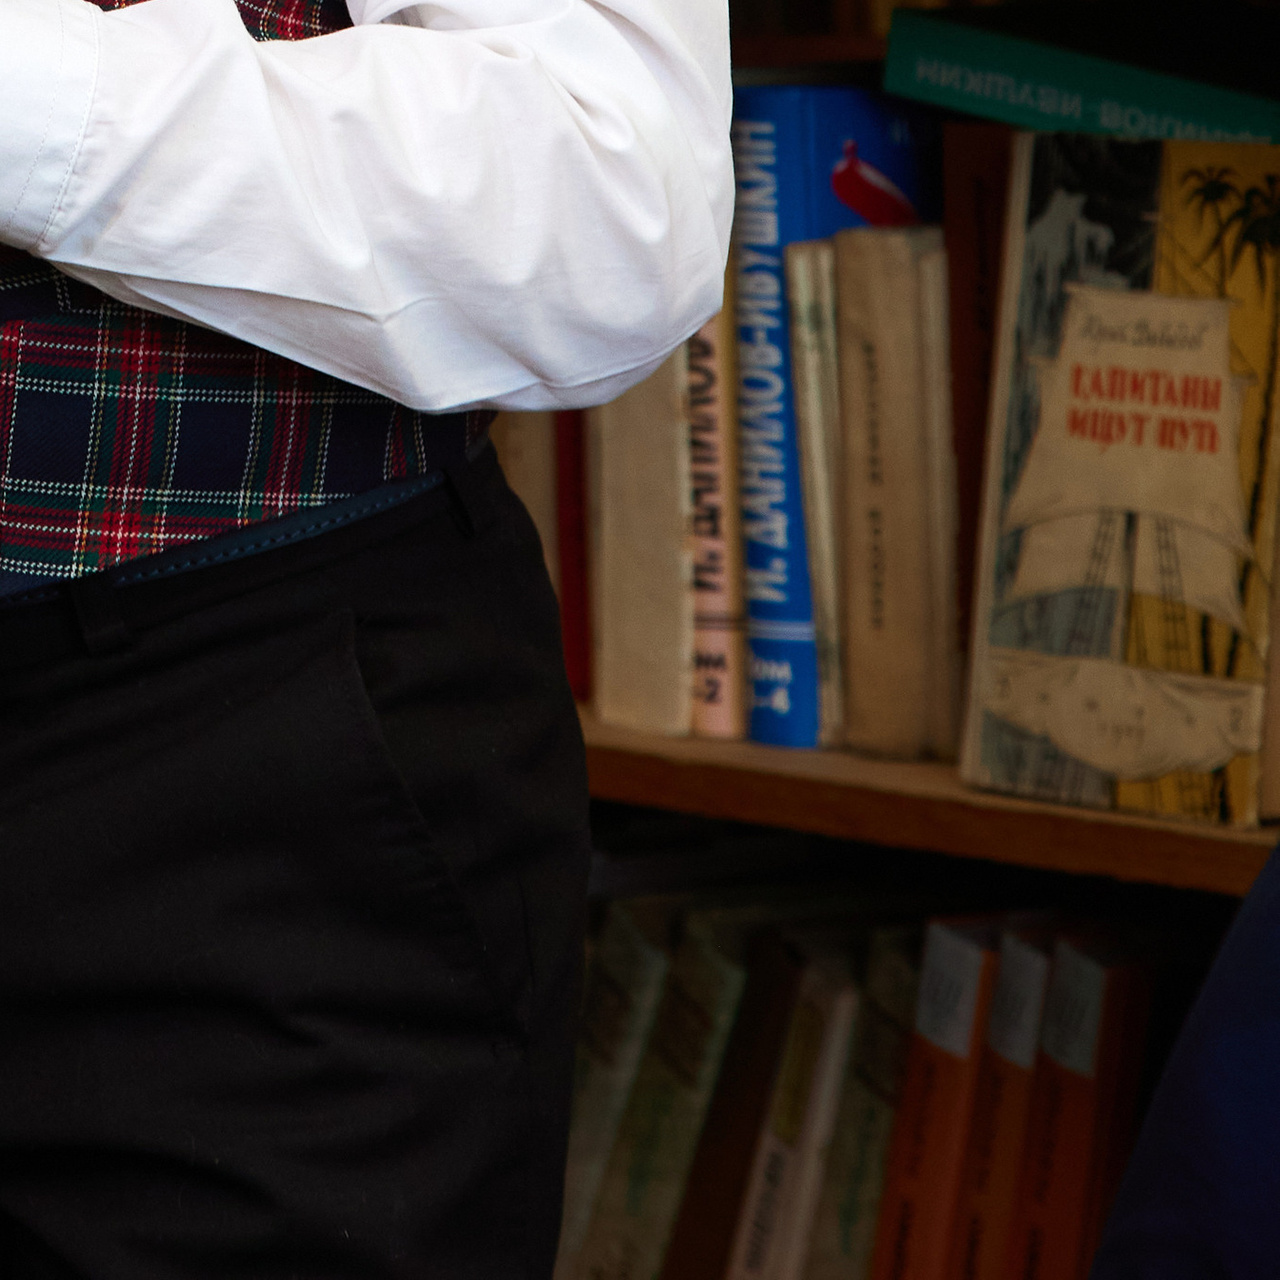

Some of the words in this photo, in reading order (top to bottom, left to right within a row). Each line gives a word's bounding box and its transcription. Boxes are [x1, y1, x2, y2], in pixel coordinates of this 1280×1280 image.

[1071, 362, 1223, 413] КАПИТАНЫ
[1066, 407, 1152, 454] ИЩУТ
[1156, 415, 1220, 455] ПУТЬ
[746, 554, 788, 604] И.
